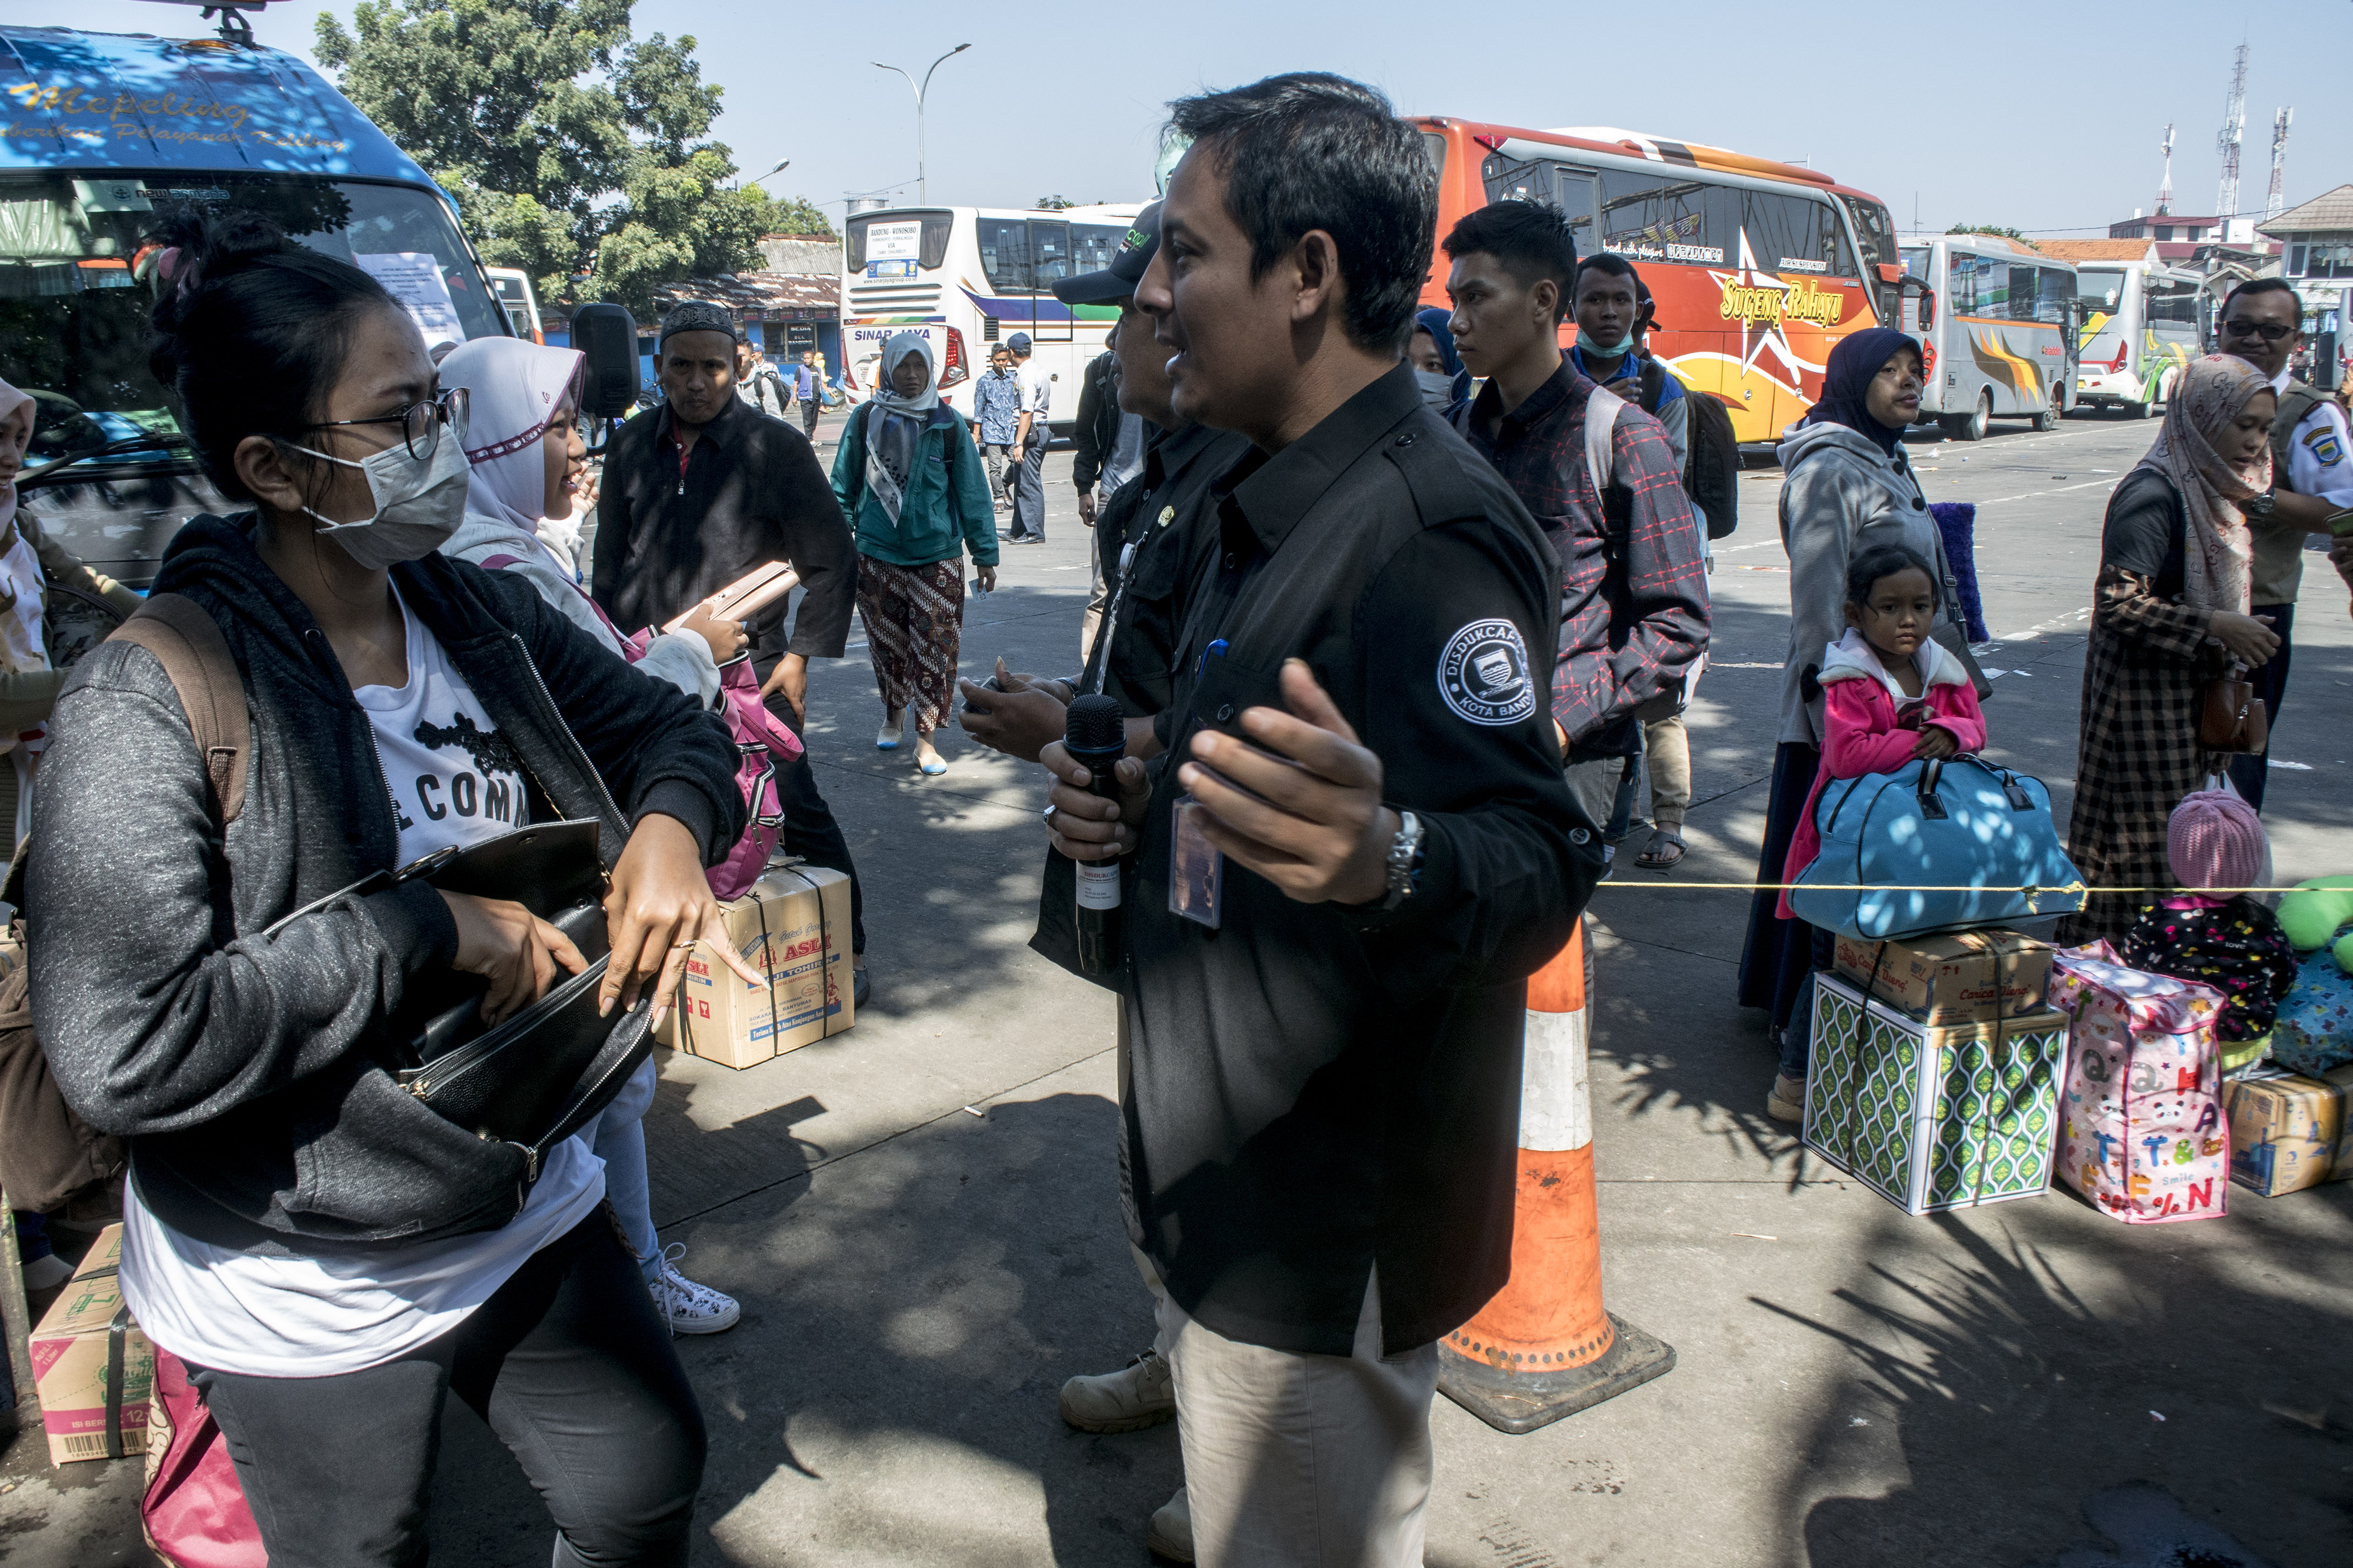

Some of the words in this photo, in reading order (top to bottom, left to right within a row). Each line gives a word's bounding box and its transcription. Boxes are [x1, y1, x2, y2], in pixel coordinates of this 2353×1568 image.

[9, 82, 252, 128] Mepeling
[112, 123, 243, 144] Pelayanan
[136, 189, 168, 199] new
[169, 186, 230, 200] armada
[892, 226, 916, 235] WONOSOBO
[1602, 238, 1622, 253] travel
[1622, 241, 1638, 255] with
[1638, 243, 1664, 260] pleasure
[1791, 260, 1825, 270] SUSPENSION
[855, 330, 892, 341] SINAR
[2045, 346, 2061, 356] aladdin
[1459, 697, 1494, 717] KOTA
[779, 926, 803, 944] Getuk
[805, 921, 832, 936] Gorng
[783, 934, 832, 962] ASLI
[2225, 942, 2246, 950] love
[686, 959, 709, 976] SLI
[787, 956, 833, 976] TOHIRN
[1959, 988, 1995, 1000] Carica
[749, 1010, 778, 1022] SOKARAA
[782, 999, 812, 1011] BANYUMAS
[753, 1029, 768, 1039] Terima
[782, 1020, 791, 1029] Atas
[792, 1013, 815, 1026] Kunjungan
[815, 1009, 824, 1018] And
[2162, 1172, 2194, 1186] Smile
[35, 1343, 54, 1362] REFILL
[45, 1348, 59, 1363] Liter
[85, 1419, 106, 1427] BERS
